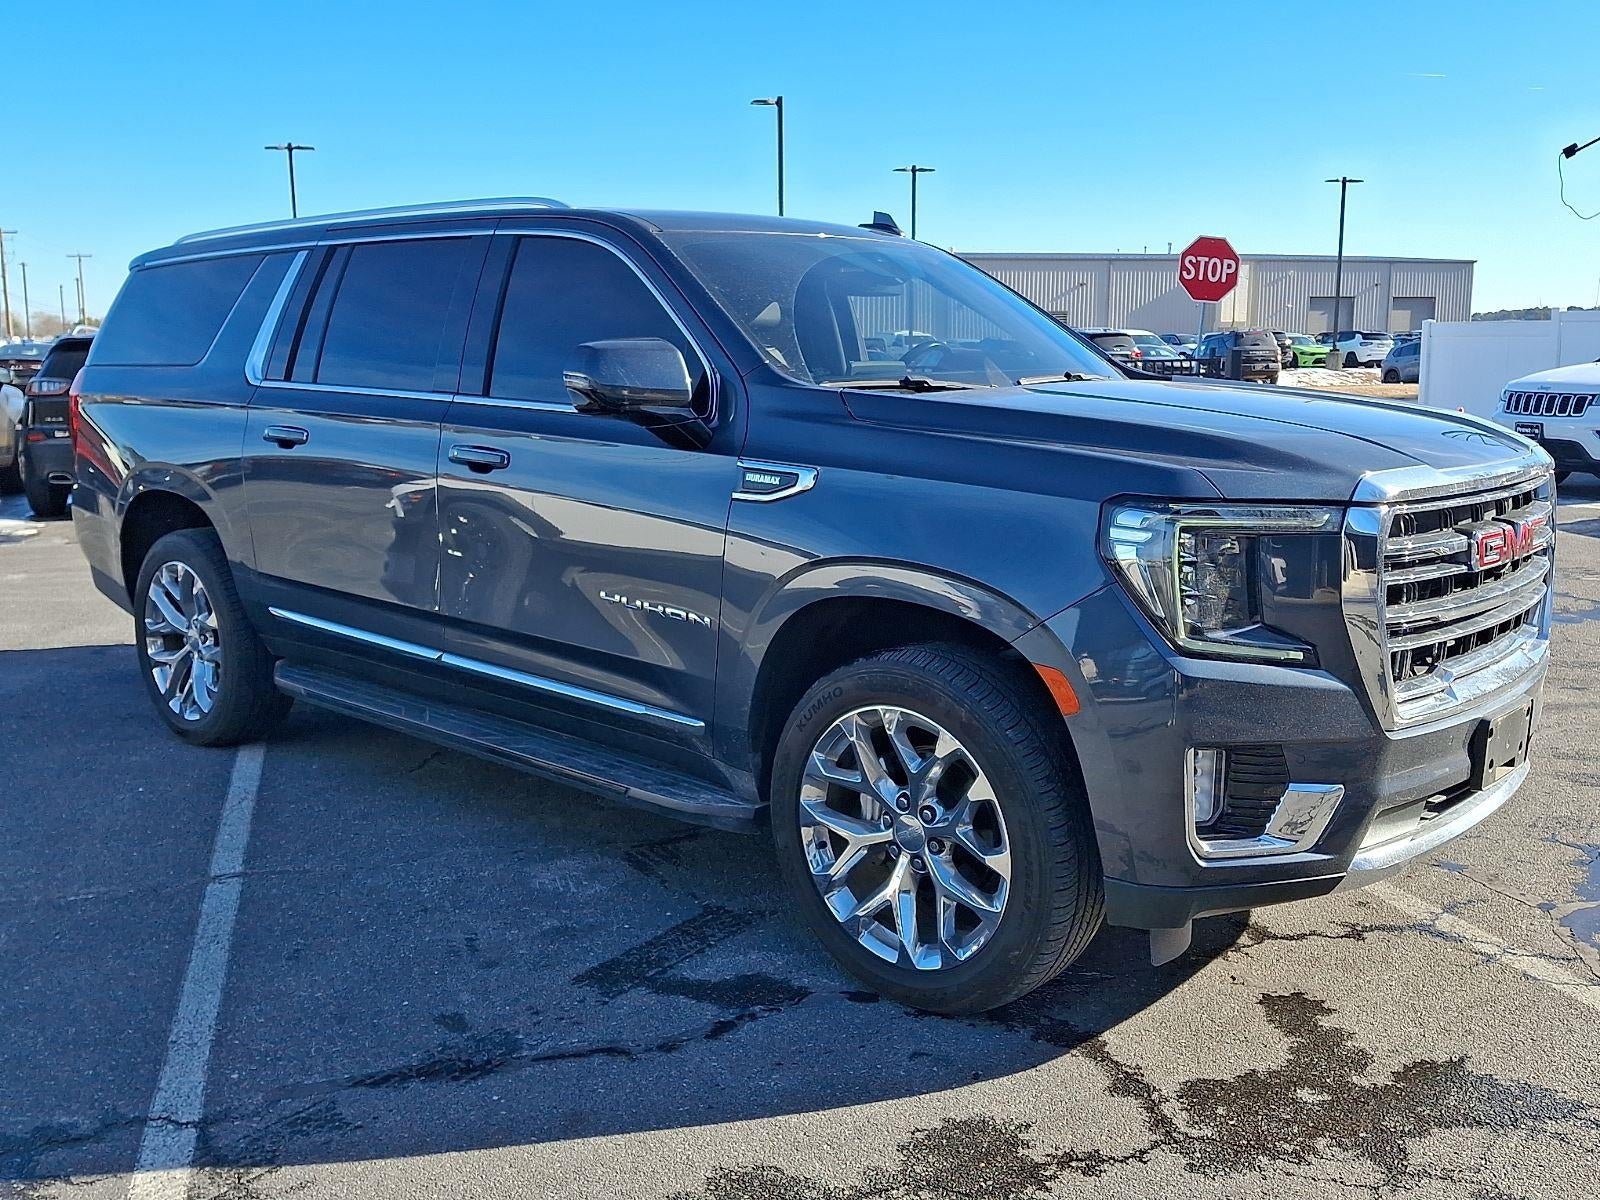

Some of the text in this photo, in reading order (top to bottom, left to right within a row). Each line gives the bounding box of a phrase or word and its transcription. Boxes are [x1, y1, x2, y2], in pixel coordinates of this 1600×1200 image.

[1182, 255, 1236, 283] STOP
[745, 473, 781, 485] DURAMAX
[1478, 517, 1547, 569] GMC
[600, 590, 711, 628] YUKON
[796, 686, 844, 732] KUMHO
